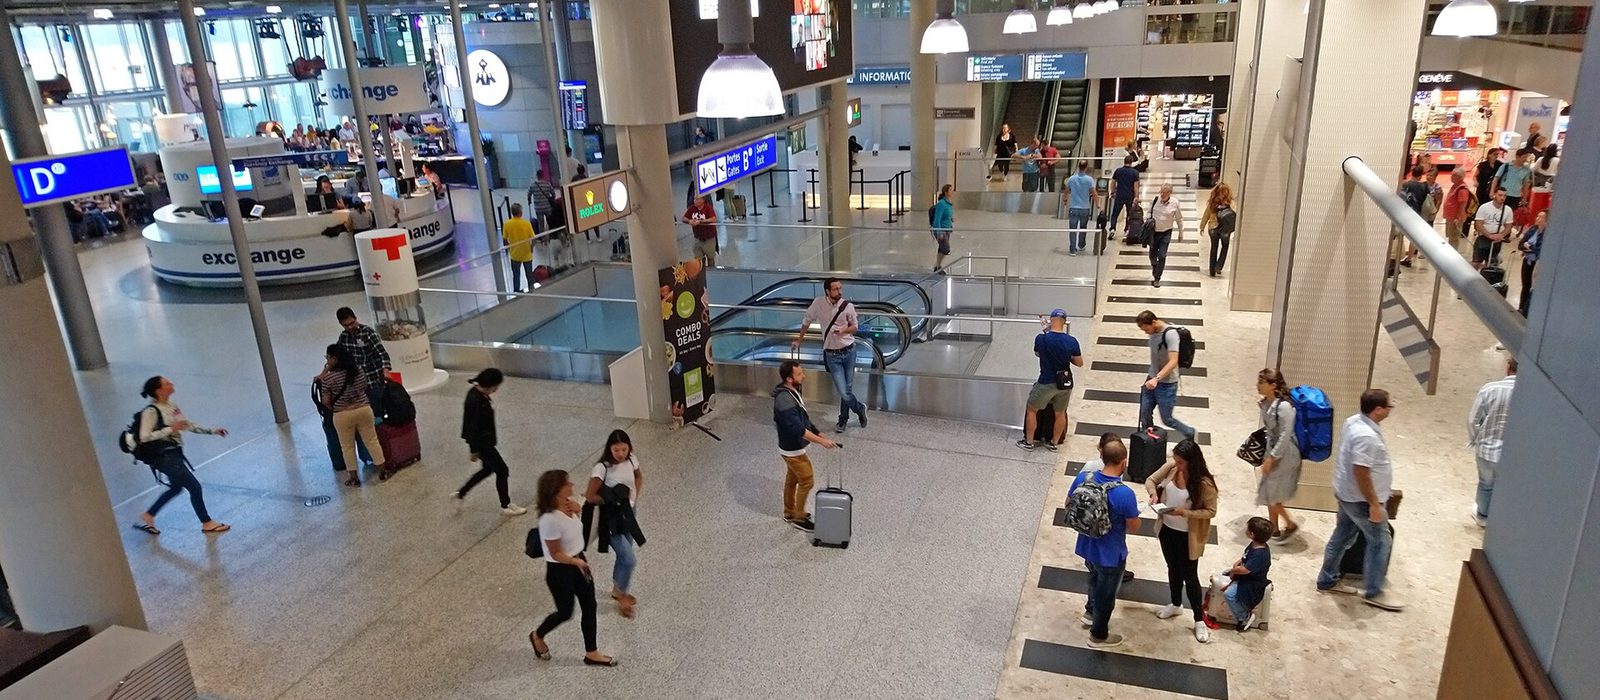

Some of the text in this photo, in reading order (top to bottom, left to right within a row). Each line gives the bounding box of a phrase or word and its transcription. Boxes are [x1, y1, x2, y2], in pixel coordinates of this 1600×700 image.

[331, 83, 399, 101] chnge
[1522, 105, 1552, 118] Winston
[756, 141, 768, 154] Sortie
[726, 150, 750, 172] Portes B
[756, 154, 765, 166] Exit
[727, 164, 740, 178] Gates
[30, 167, 55, 195] D
[579, 202, 604, 219] ROLEX
[202, 248, 306, 265] excange
[675, 321, 702, 338] COMBO
[677, 330, 702, 347] DEALS
